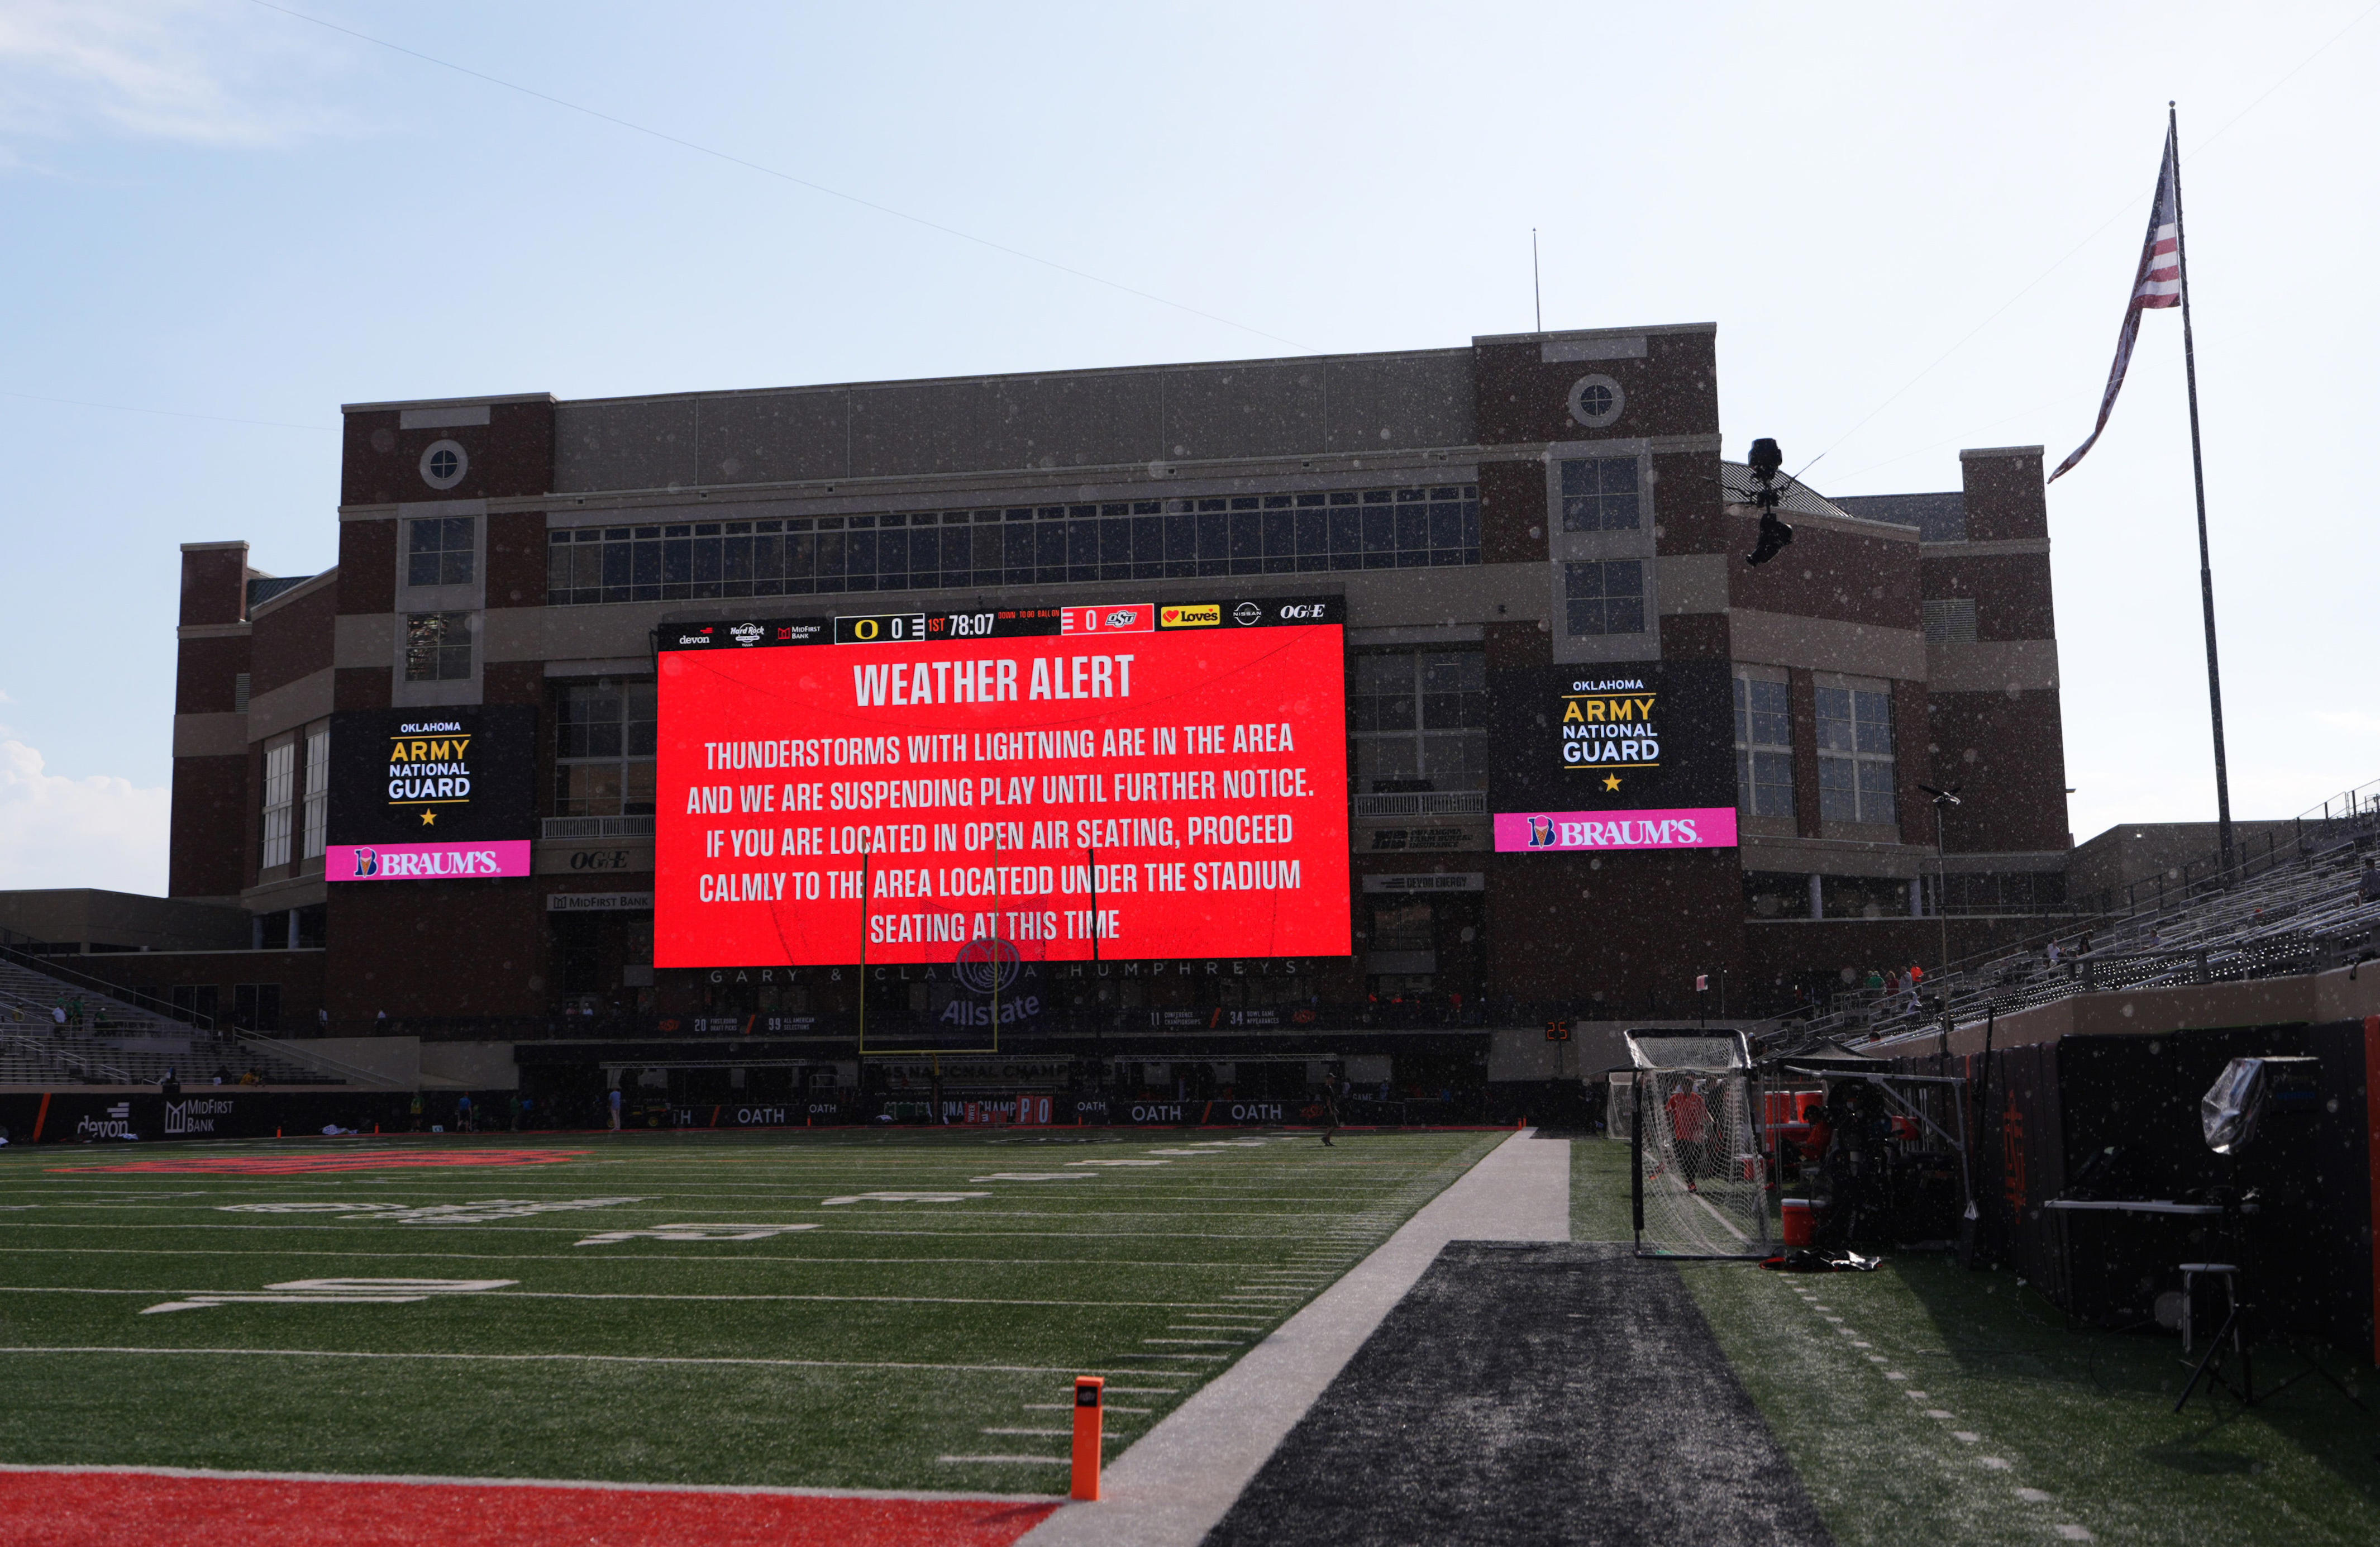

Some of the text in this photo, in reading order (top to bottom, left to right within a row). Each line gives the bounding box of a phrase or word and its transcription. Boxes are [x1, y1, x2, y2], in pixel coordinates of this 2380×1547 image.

[891, 618, 903, 639] 0
[928, 613, 994, 636] 1ST 78:07
[1086, 610, 1096, 631] 0
[748, 626, 765, 635] Rock
[680, 635, 709, 644] devon
[853, 654, 1134, 706] WEATHER ALERT
[1573, 679, 1643, 691] OKLAHOMA
[1563, 698, 1655, 722] ARMY
[401, 722, 461, 732] OKLAHOMA
[1563, 723, 1657, 739] NATIONAL
[390, 740, 470, 761] ARMY
[705, 723, 1294, 769] THUNDERSTORMS WITH LIGHTNING ARE IN THE AREA
[1563, 740, 1659, 763] GUARD
[389, 762, 470, 777] NATIONAL
[388, 778, 470, 799] GUARD
[687, 768, 1314, 814] AND WE ARE SUSPENDING PLAY UNTIL FURTHER NOTICE.
[707, 815, 1292, 857] IF YOU ARE LOCATED IN OPEN AIR SEATING, PROCEED
[1559, 819, 1697, 846] BRAUM'S
[380, 851, 497, 876] BRAUM'S
[700, 860, 1300, 902] CALMLY TO THE AREA LOCATEDD UNDER THE STADIUM
[1406, 877, 1467, 888] DEVON ENERGY
[620, 897, 648, 906] BANK
[871, 910, 1119, 943] SEATING AT THIS TIME
[710, 969, 799, 983] GARY
[831, 969, 842, 981] &
[1071, 961, 1296, 977] HUMPHREYS
[939, 995, 1040, 1026] Allstate
[1151, 1012, 1160, 1025] 11
[1230, 1011, 1243, 1025] 34
[694, 1018, 707, 1032] 20
[769, 1018, 781, 1031] 99
[1547, 1022, 1567, 1039] 25
[809, 1104, 836, 1113] OATH
[1020, 1098, 1030, 1122] P
[1077, 1102, 1105, 1111] OATH
[1132, 1105, 1181, 1121] OATH
[1232, 1104, 1281, 1120] OATH
[673, 1110, 691, 1124] TH
[738, 1108, 785, 1124] OATH
[78, 1115, 128, 1137] devon
[187, 1118, 214, 1133] BANK
